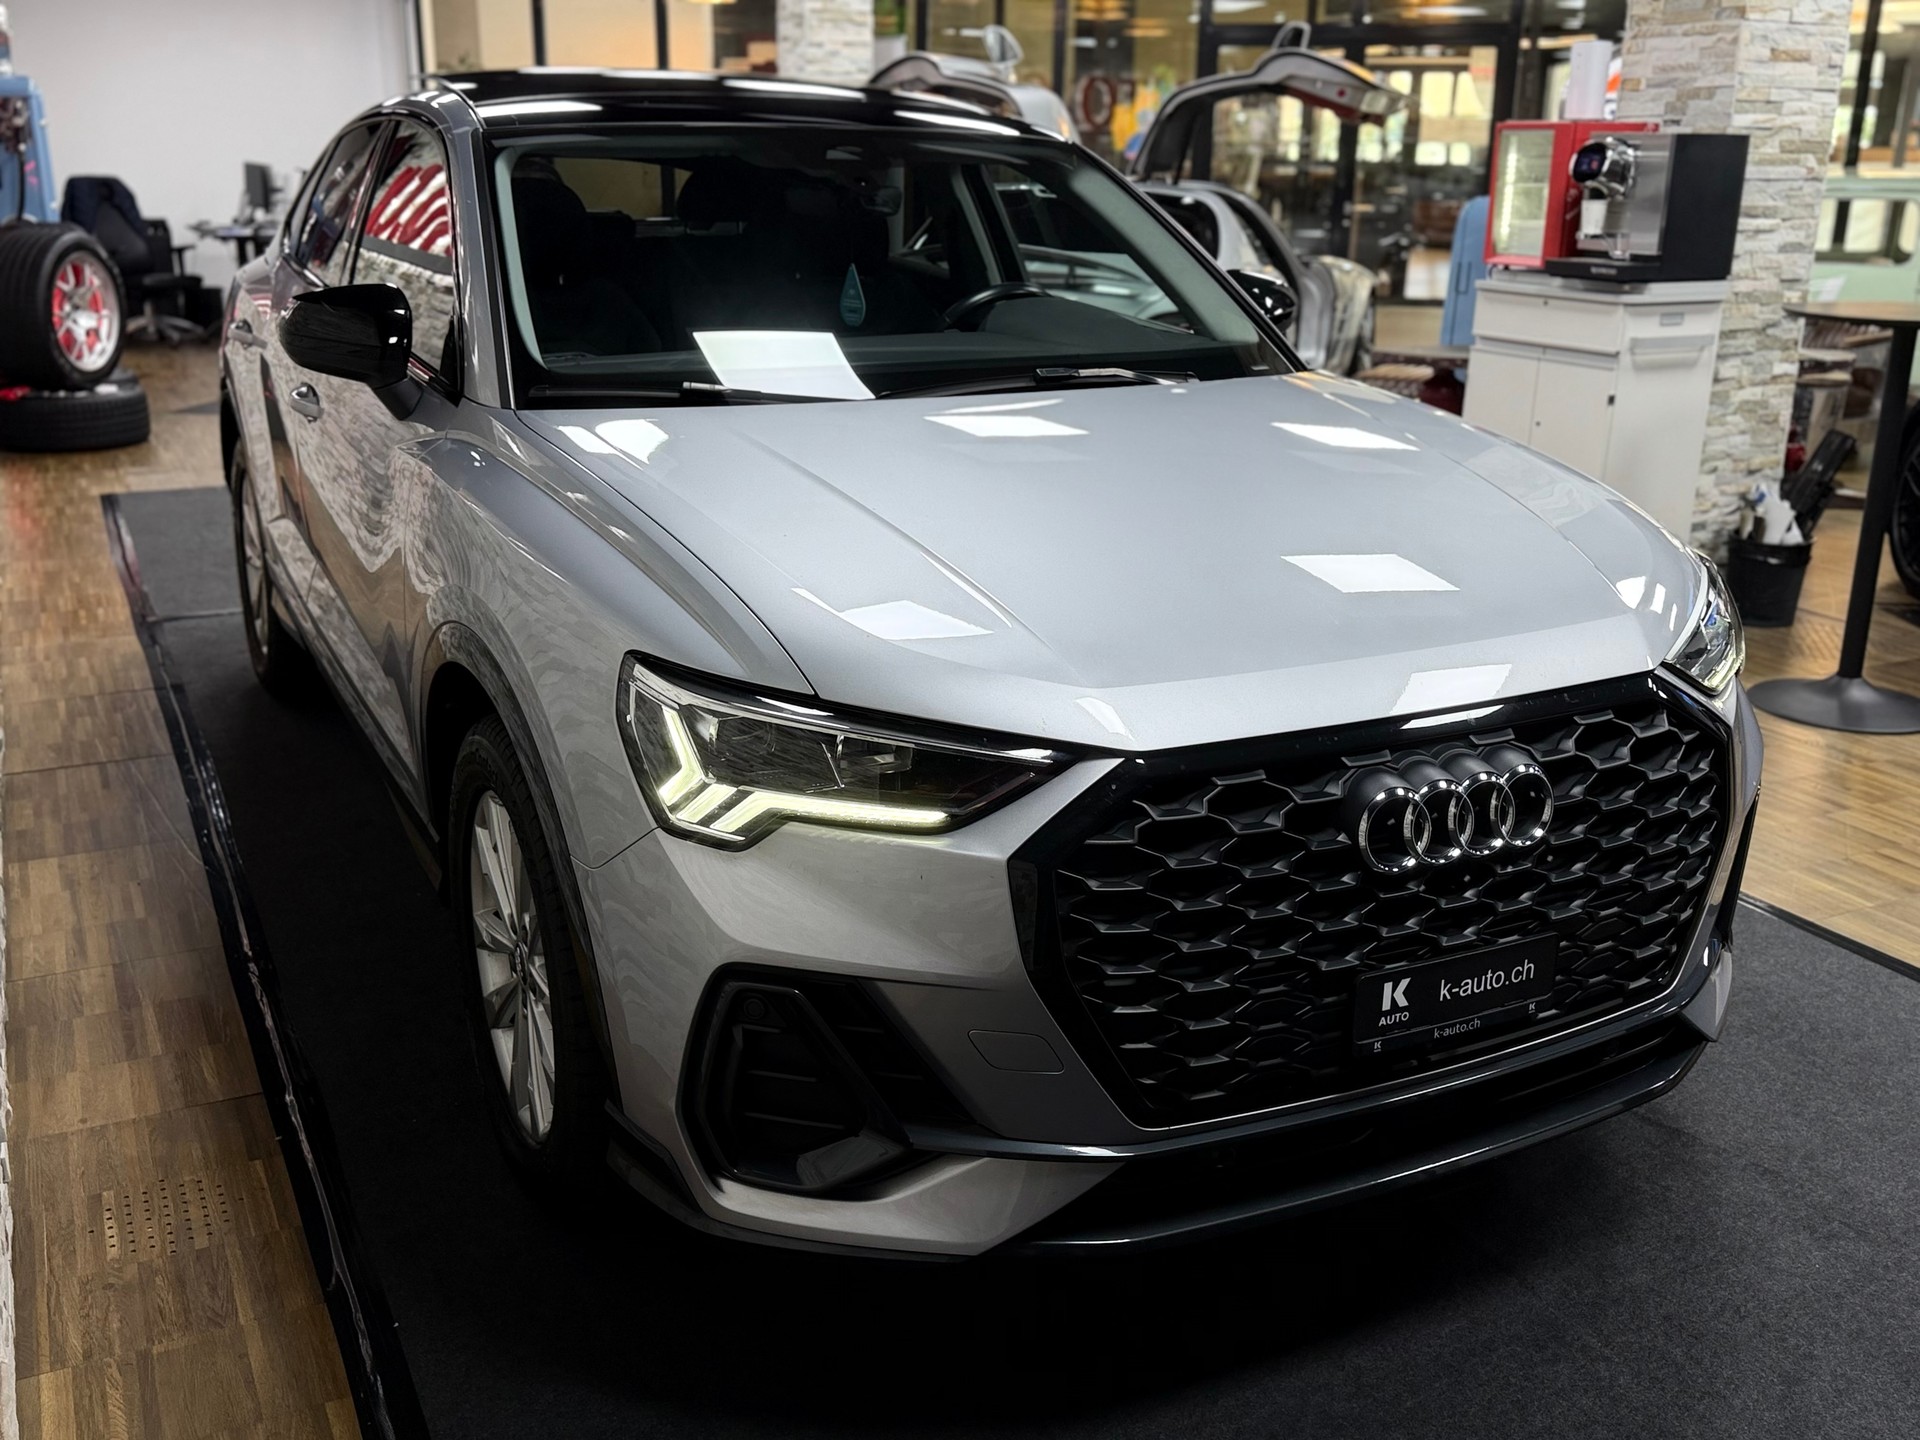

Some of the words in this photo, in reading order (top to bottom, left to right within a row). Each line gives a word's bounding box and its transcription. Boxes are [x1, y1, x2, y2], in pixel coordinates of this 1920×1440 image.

[1382, 977, 1411, 1011] K
[1439, 959, 1535, 1002] k-auto.ch
[1378, 1011, 1410, 1027] AUTO
[1433, 1018, 1481, 1039] k-auto.ch
